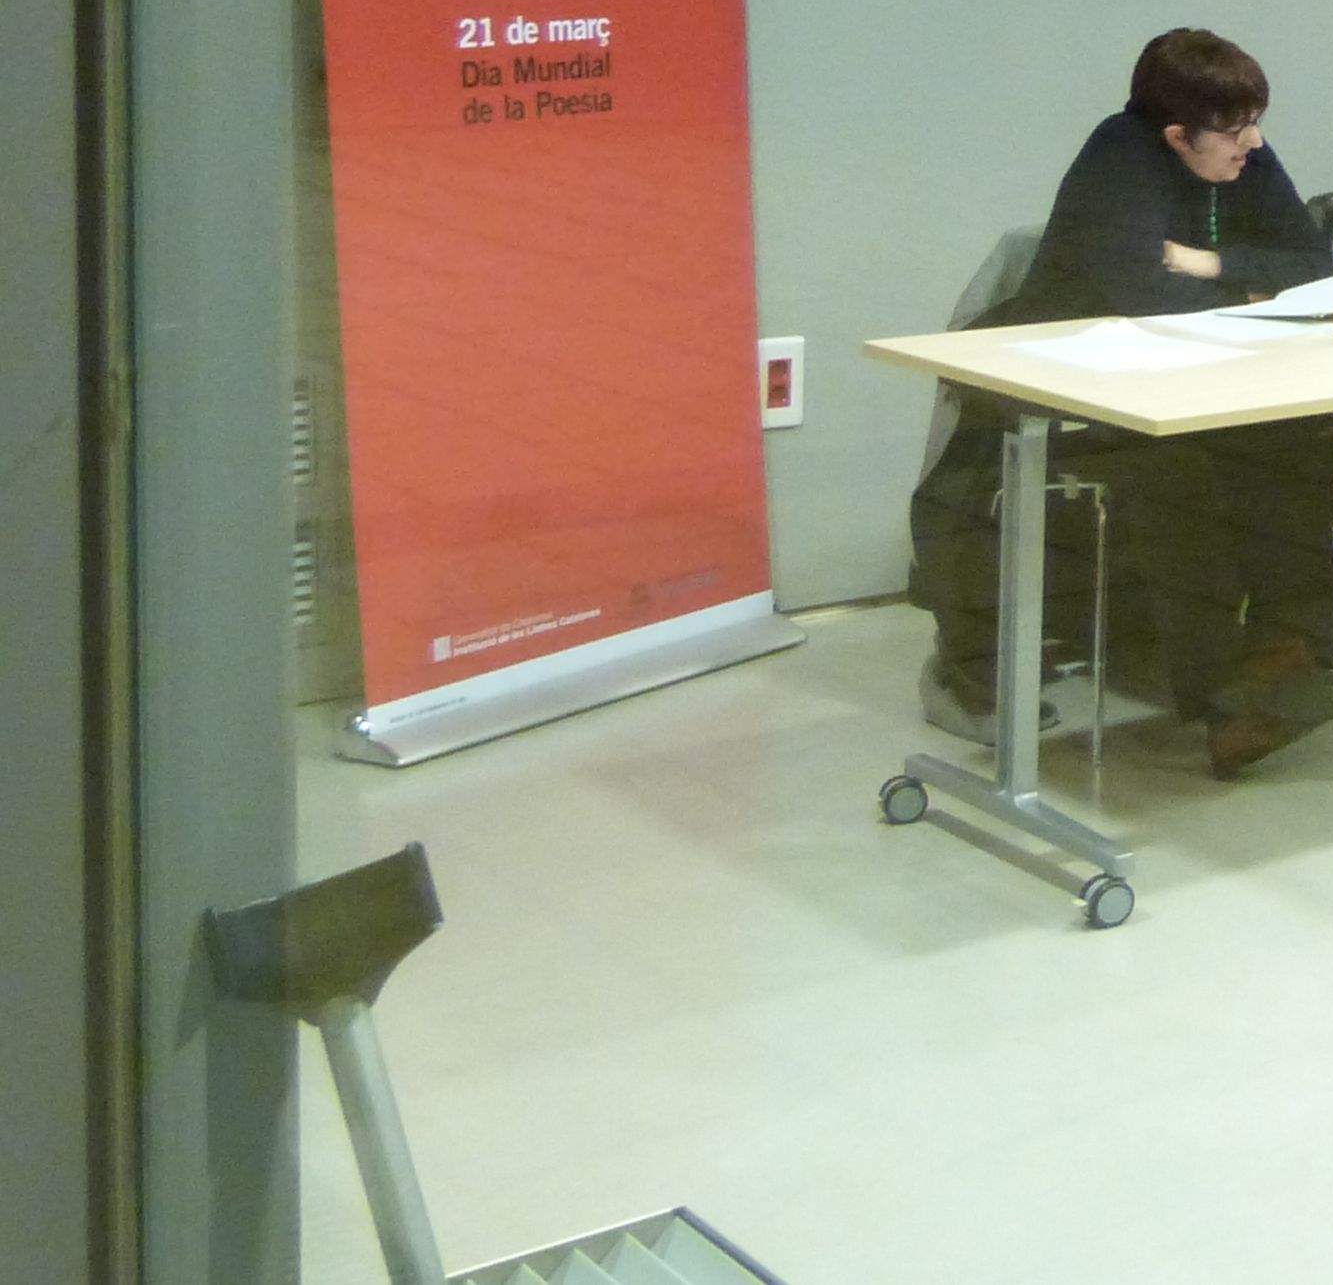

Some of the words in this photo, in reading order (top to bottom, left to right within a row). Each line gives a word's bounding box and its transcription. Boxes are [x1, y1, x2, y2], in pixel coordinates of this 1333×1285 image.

[458, 16, 496, 49] 21
[506, 15, 540, 46] de
[547, 17, 611, 48] març
[461, 59, 503, 88] Dia
[513, 51, 611, 84] Mundial
[463, 98, 493, 125] de
[504, 94, 526, 121] la
